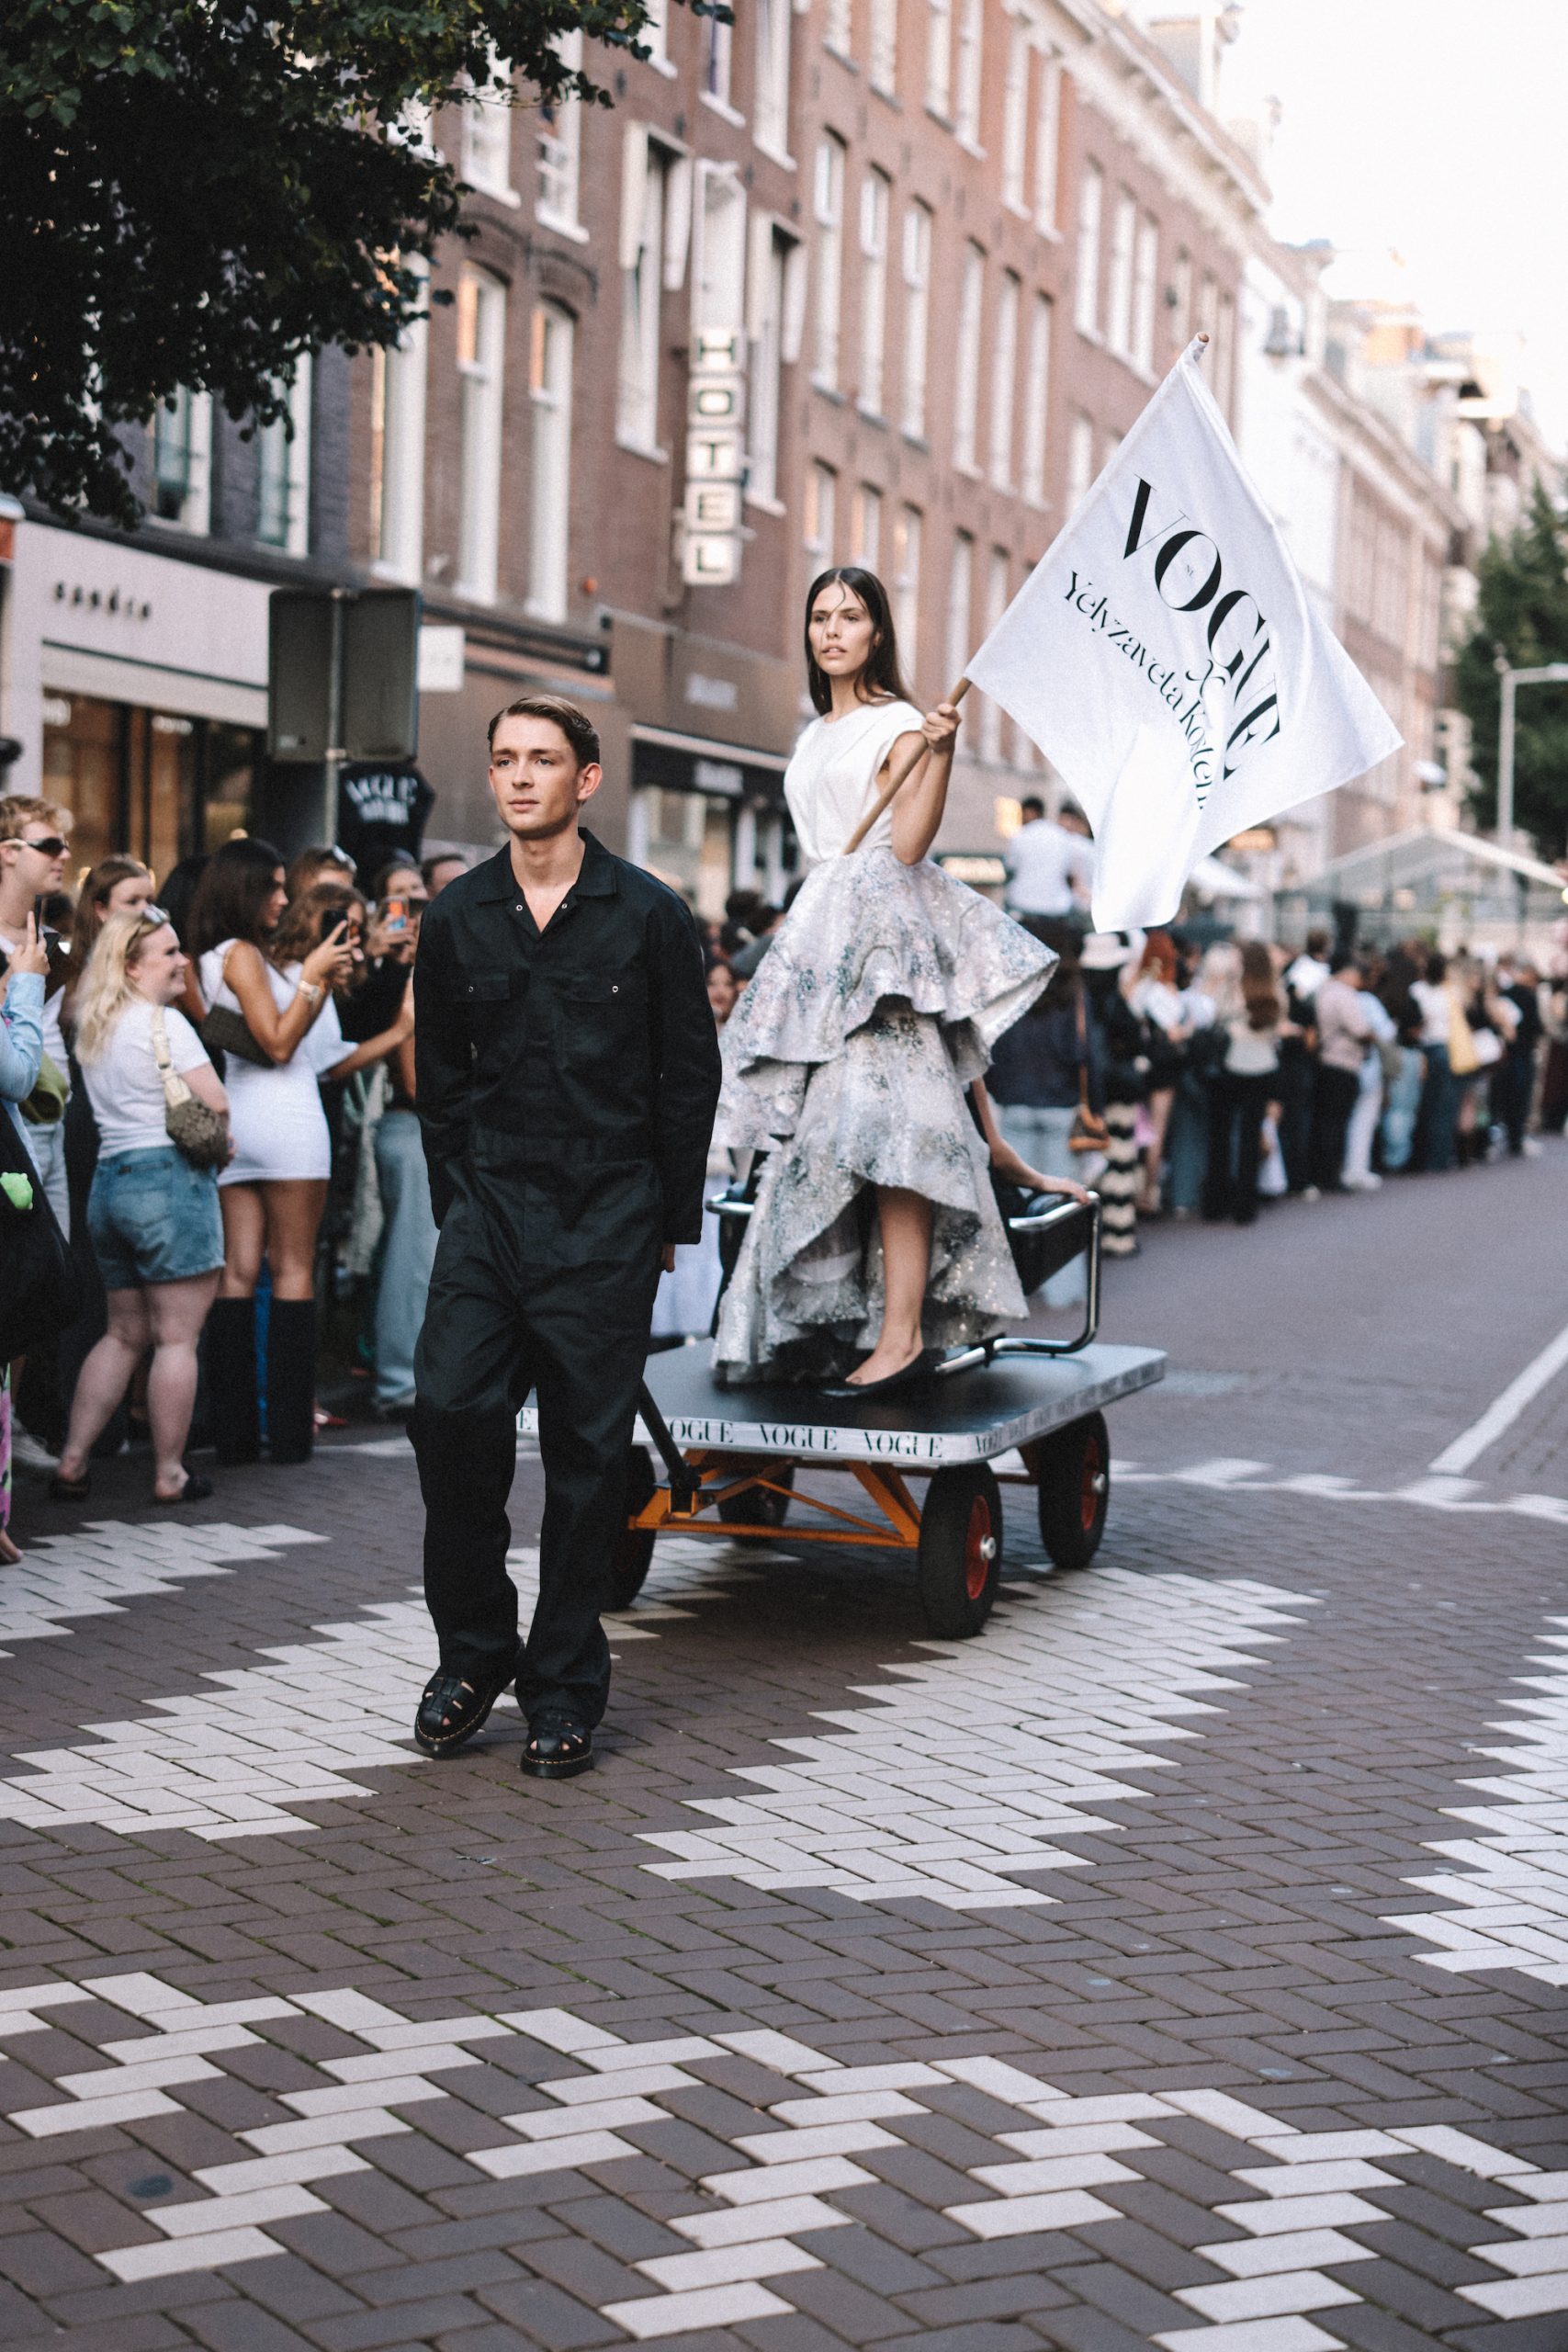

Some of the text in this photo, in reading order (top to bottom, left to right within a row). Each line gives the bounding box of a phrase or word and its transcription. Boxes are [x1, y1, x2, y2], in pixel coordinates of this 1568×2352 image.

[695, 335, 734, 573] HOTEL
[1063, 570, 1184, 711] Yelyzaveta
[1122, 473, 1280, 781] VOGUE
[668, 1418, 943, 1459] OGUE VOGUE VOGUE
